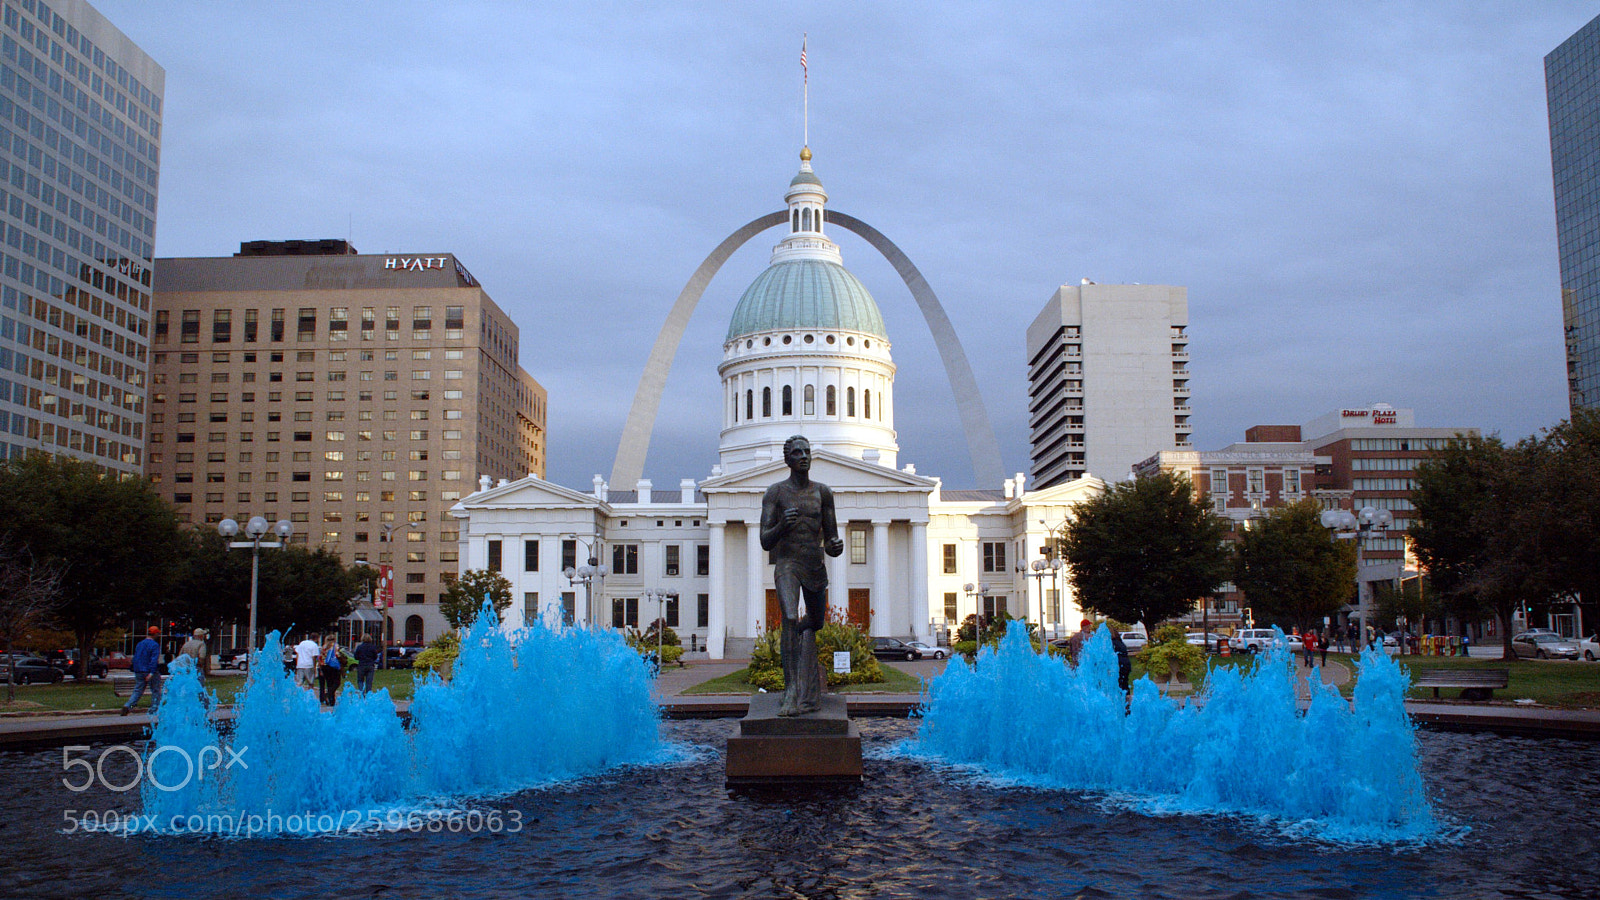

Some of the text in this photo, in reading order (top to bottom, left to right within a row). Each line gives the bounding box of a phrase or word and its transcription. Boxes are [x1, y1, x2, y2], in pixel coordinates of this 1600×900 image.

[385, 258, 447, 272] HYATT
[1372, 409, 1396, 417] PLAZA
[1374, 416, 1396, 424] HOTEL
